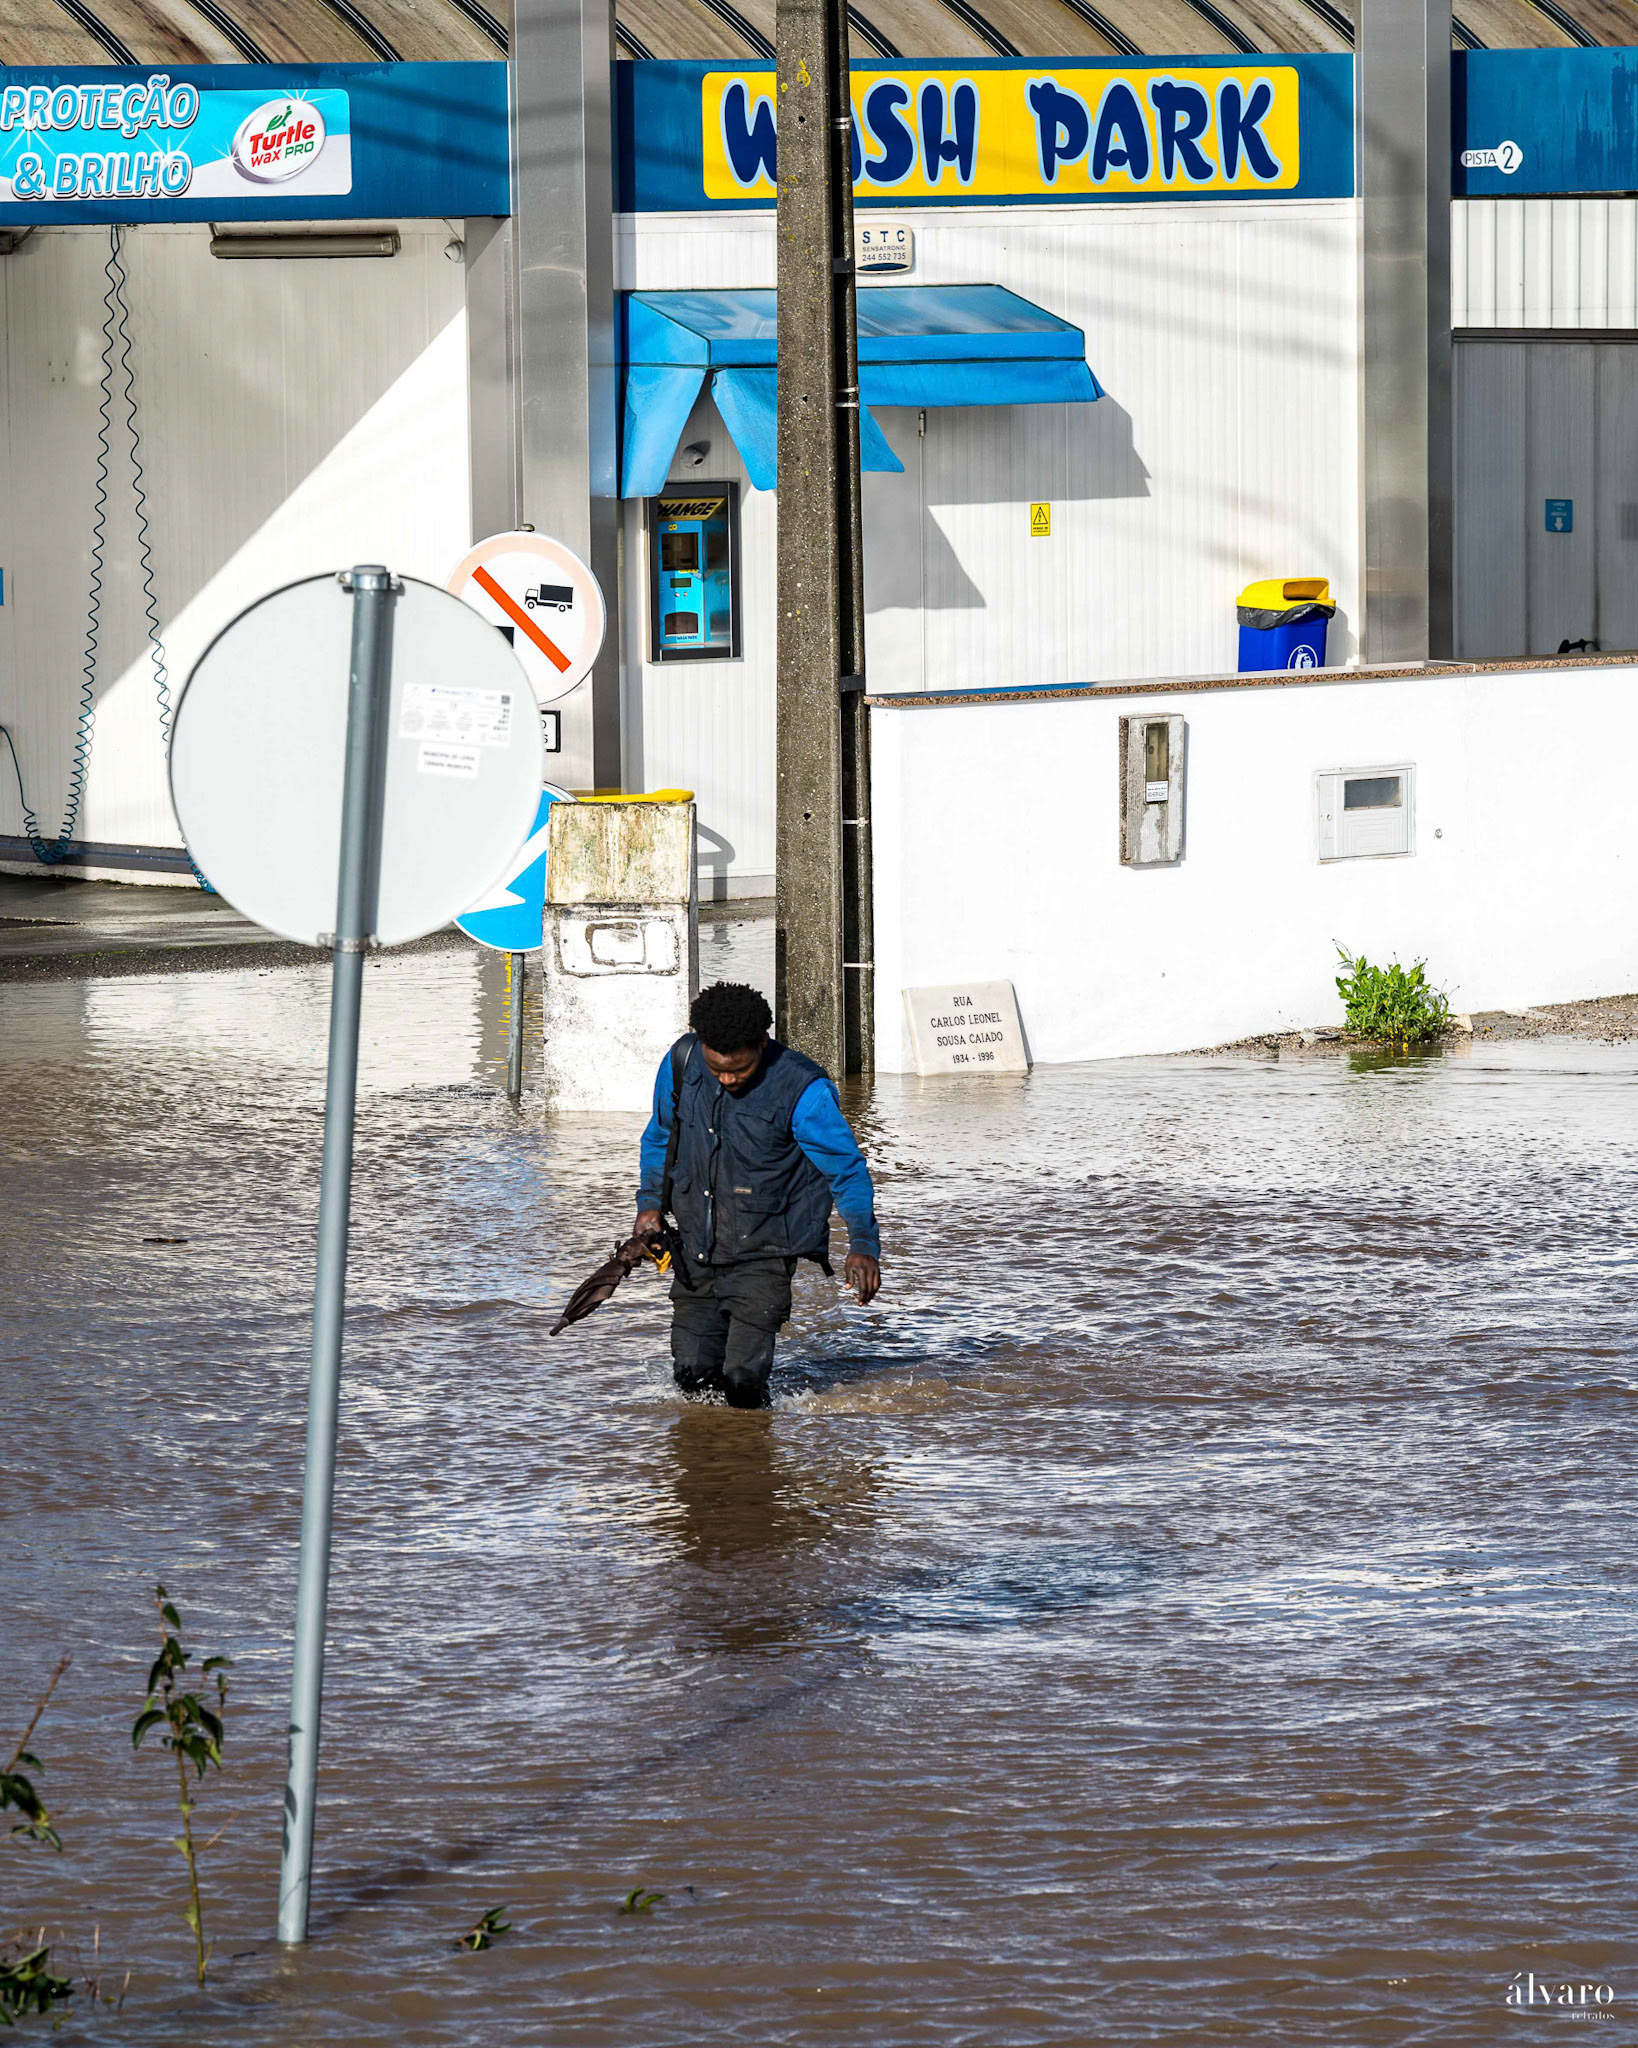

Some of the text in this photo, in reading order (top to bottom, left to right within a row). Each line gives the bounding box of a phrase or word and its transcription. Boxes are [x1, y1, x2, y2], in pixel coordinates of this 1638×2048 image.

[1, 75, 199, 137] PROTEÇÃO
[250, 120, 315, 155] Turtle
[721, 74, 1283, 188] WSH PARK
[251, 140, 314, 168] wax PRO
[1465, 145, 1514, 169] PISTA 2
[12, 151, 192, 198] & BRILHO
[893, 252, 906, 260] 735
[953, 996, 973, 1006] RUA
[930, 1012, 1002, 1028] CARLOS LEONEL
[937, 1031, 1003, 1046] SOUSA CAIADO
[953, 1054, 969, 1063] 1934
[978, 1051, 995, 1062] 1996
